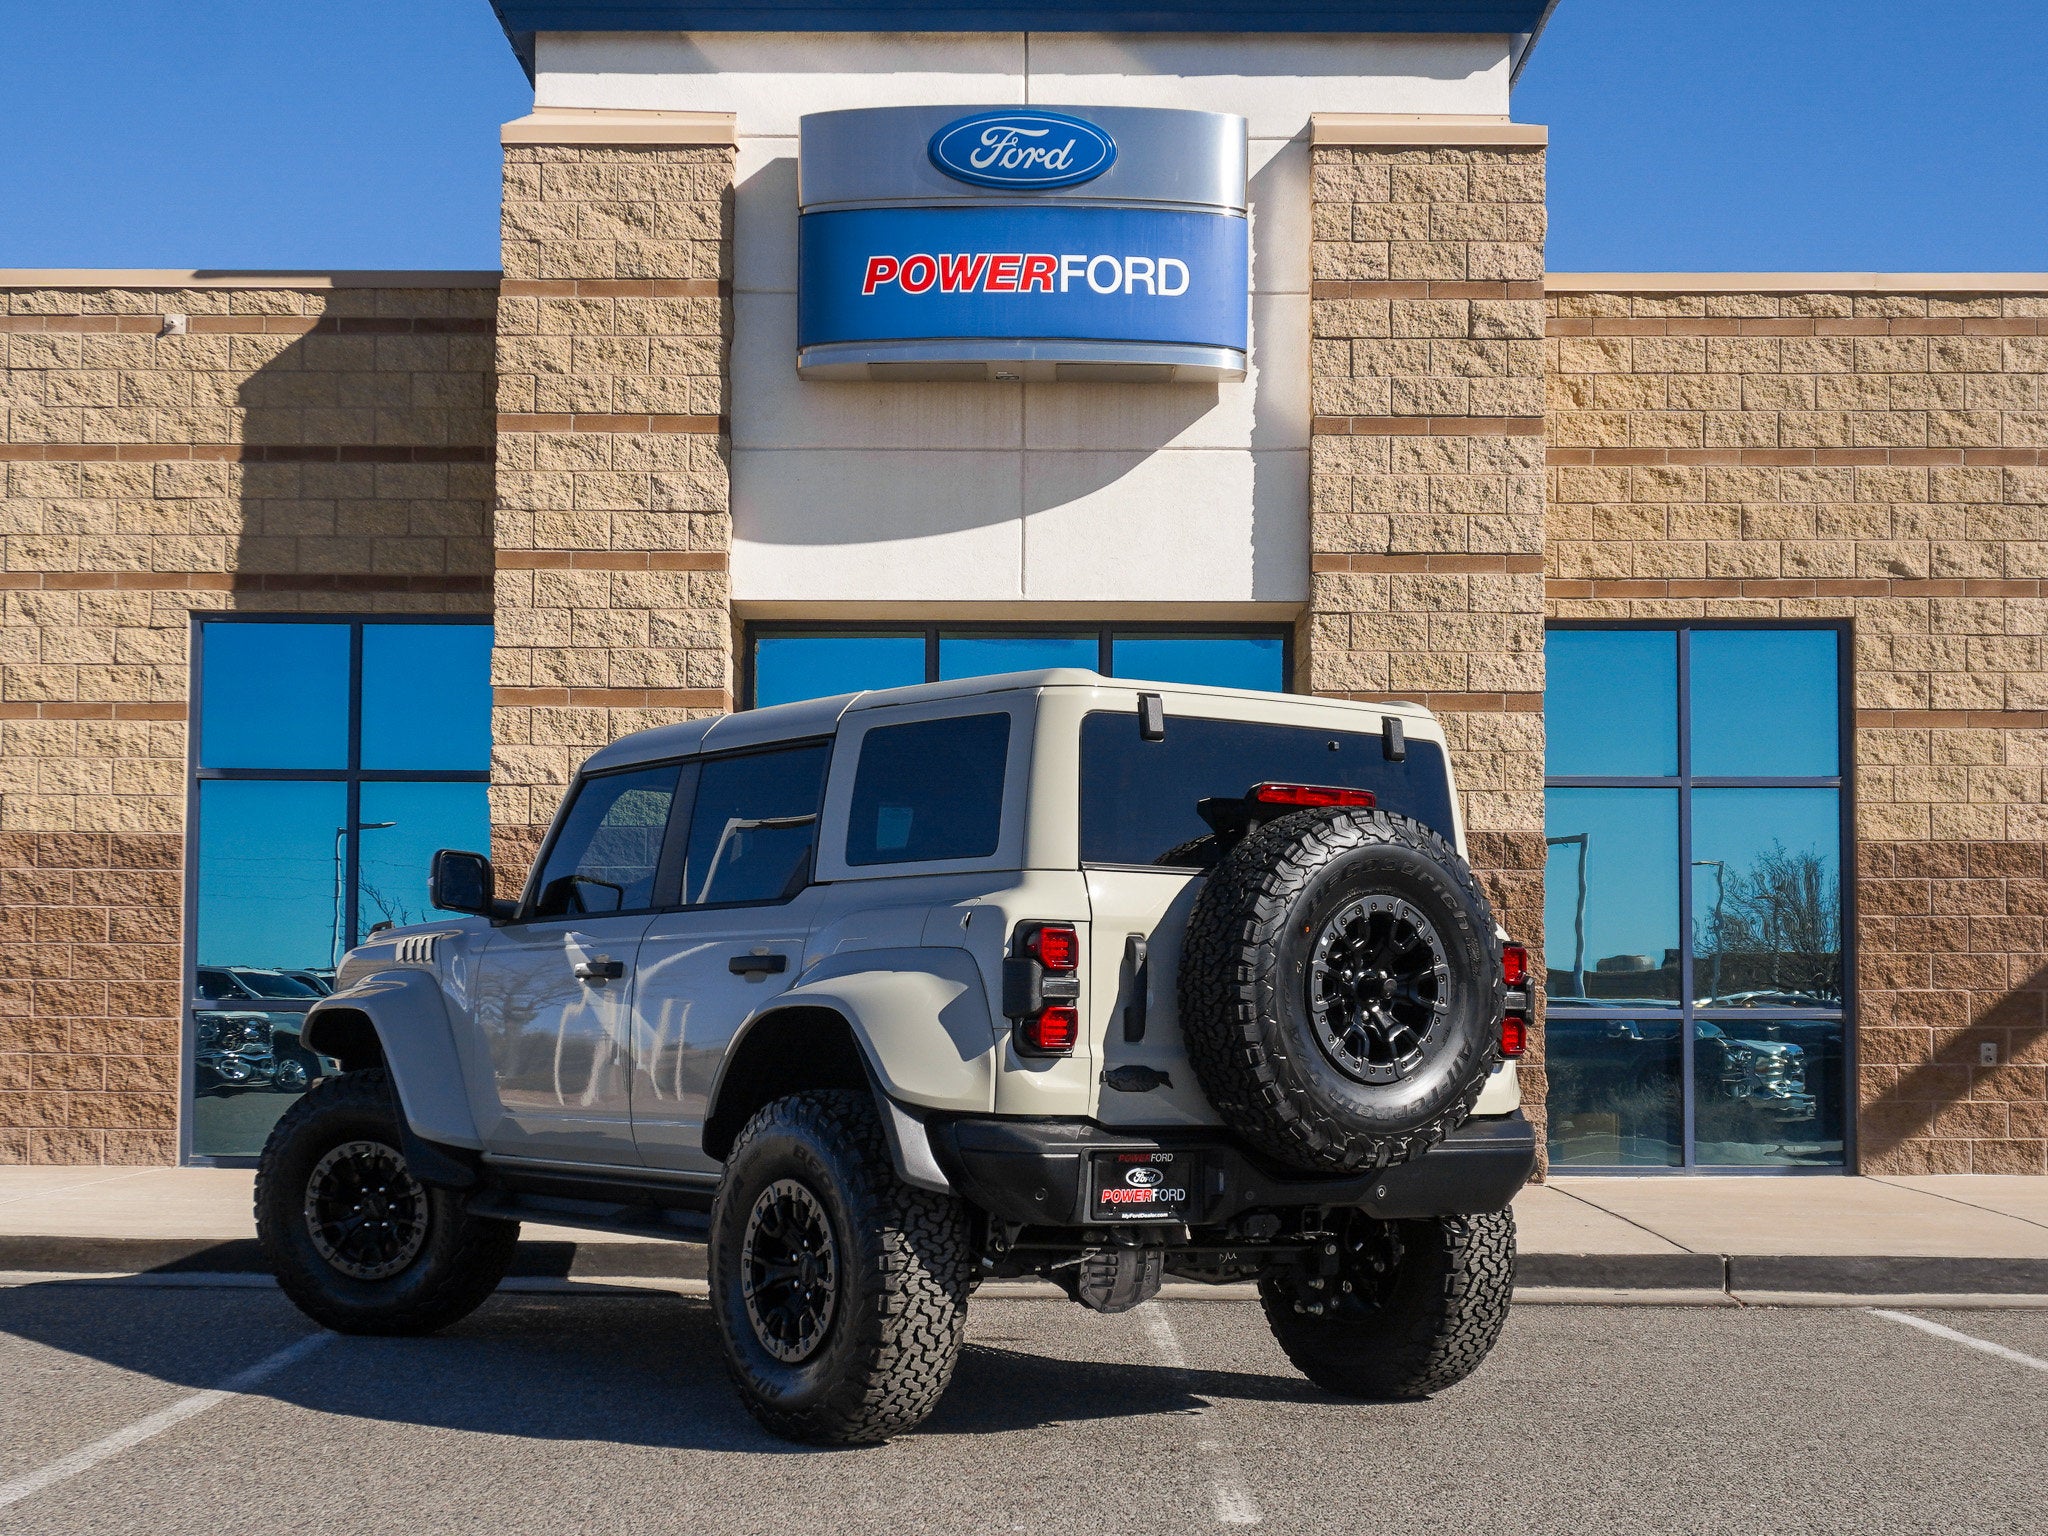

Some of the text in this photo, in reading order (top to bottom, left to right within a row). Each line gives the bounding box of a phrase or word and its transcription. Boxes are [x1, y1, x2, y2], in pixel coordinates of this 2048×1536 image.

[970, 125, 1075, 170] Ford
[861, 253, 1190, 296] POWERFORD
[1118, 1153, 1174, 1163] POWERFORD
[1133, 1168, 1156, 1183] Ford
[1101, 1188, 1186, 1204] POWERFORD
